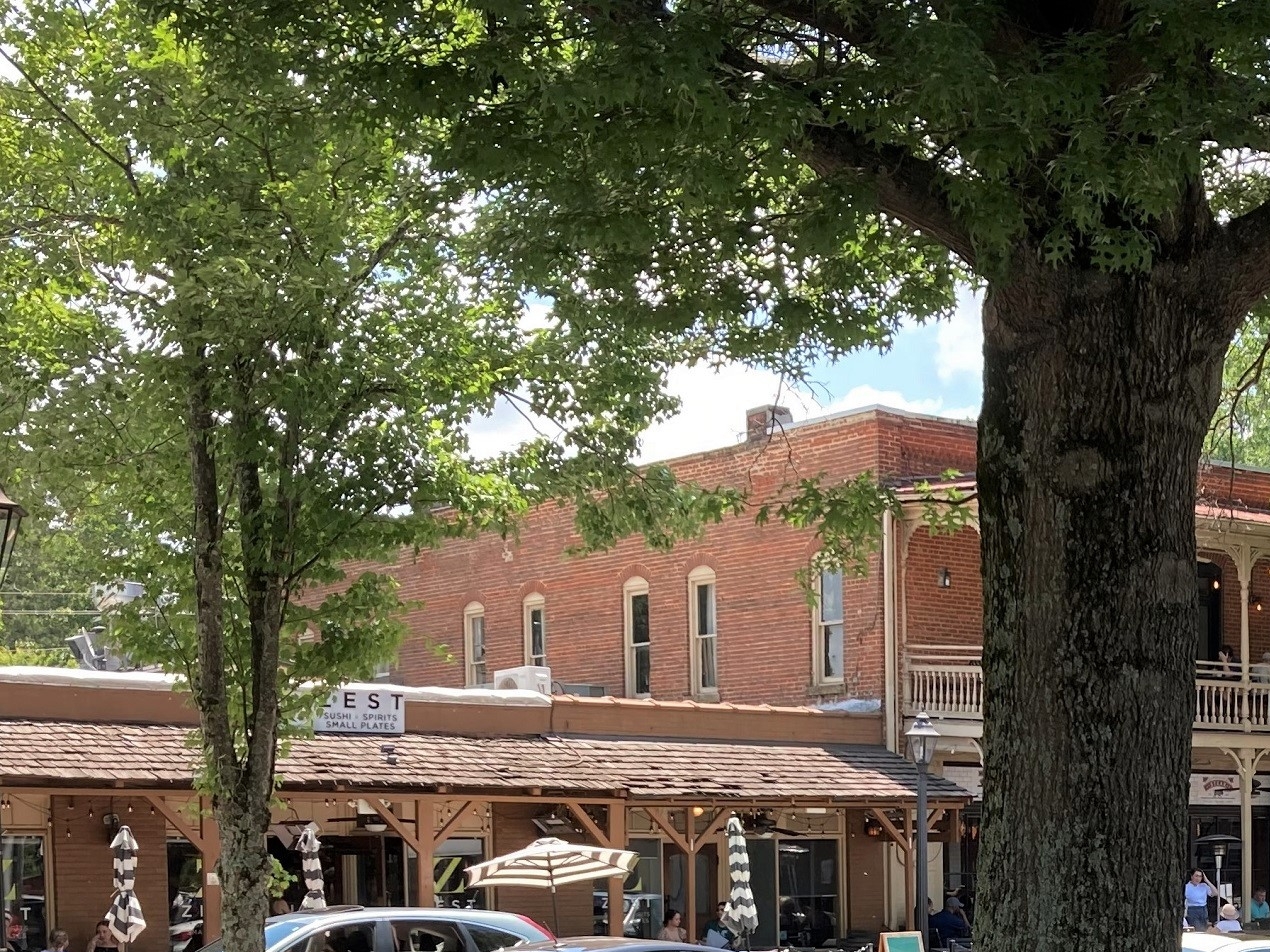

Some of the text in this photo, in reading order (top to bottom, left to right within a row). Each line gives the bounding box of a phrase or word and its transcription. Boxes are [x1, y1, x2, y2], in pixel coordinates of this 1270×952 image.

[319, 691, 404, 710] EST
[362, 713, 398, 722] SPIRITS
[326, 721, 395, 731] SMALL PLATES
